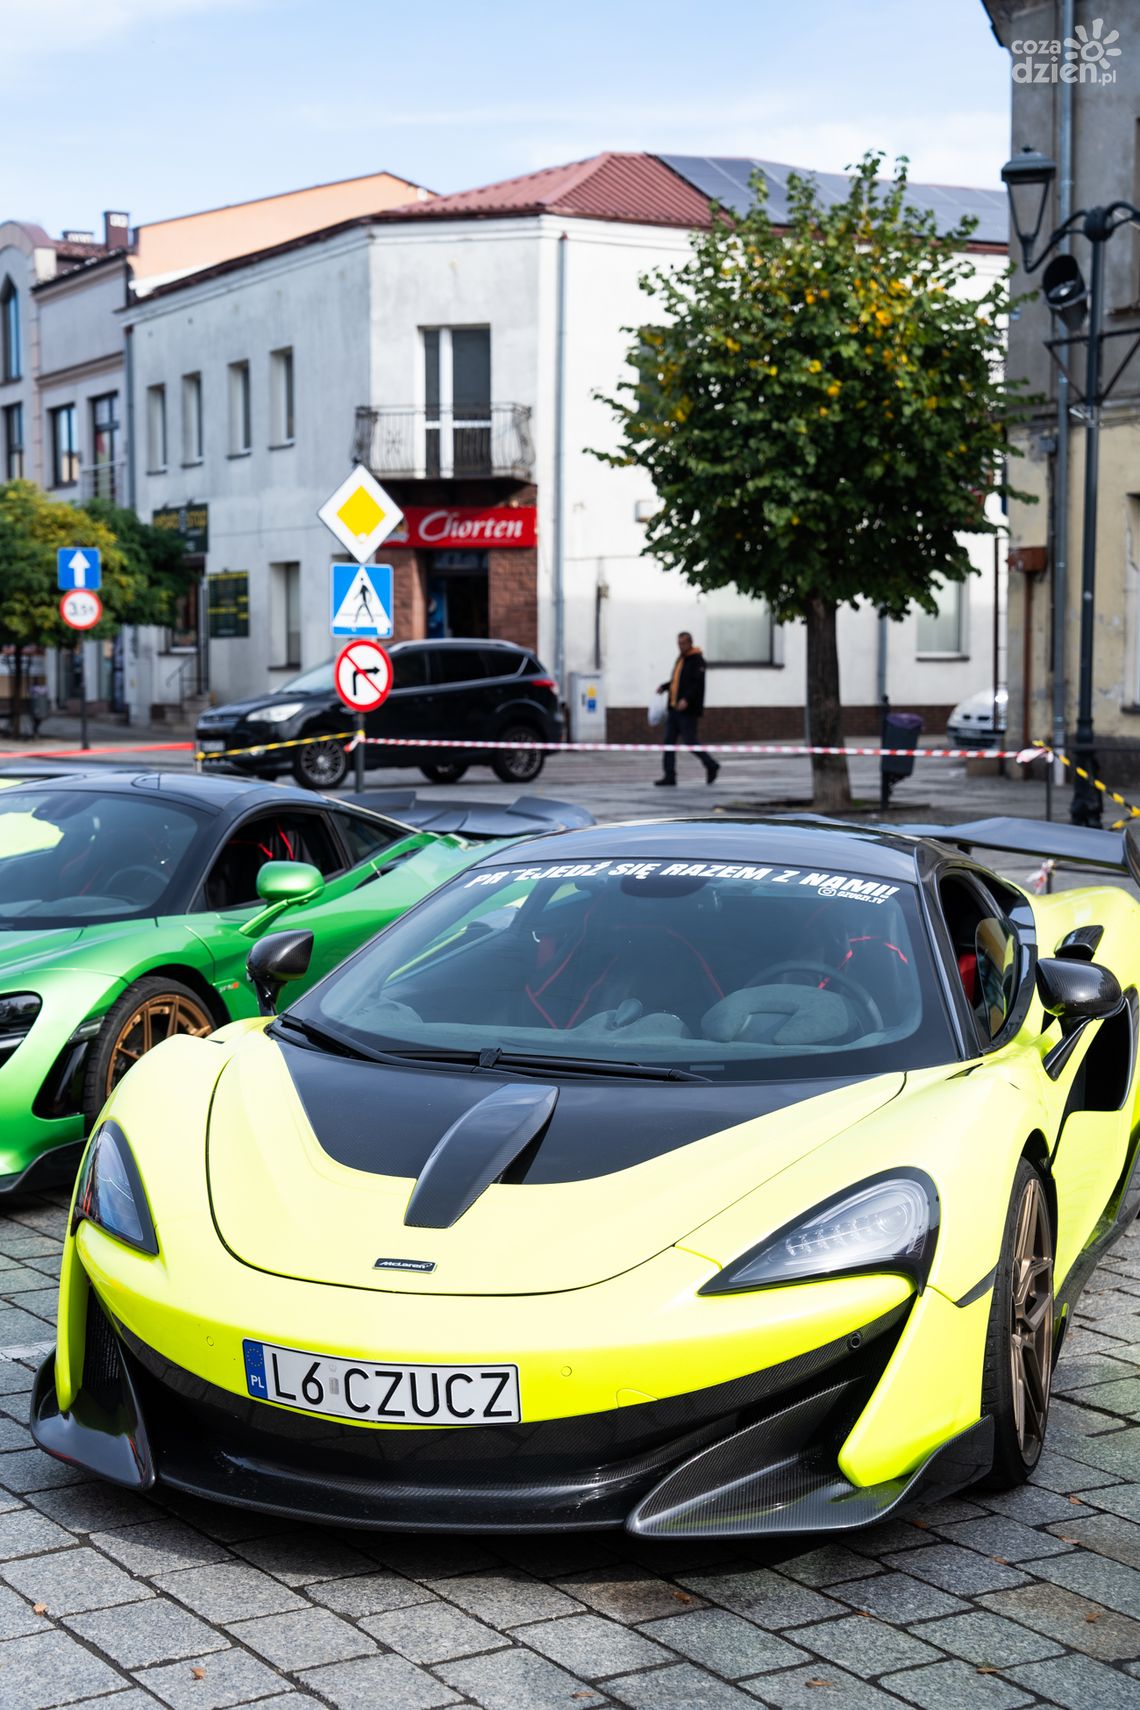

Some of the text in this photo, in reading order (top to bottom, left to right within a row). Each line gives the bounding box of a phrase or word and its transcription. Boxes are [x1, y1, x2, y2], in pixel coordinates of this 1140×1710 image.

[418, 510, 524, 542] Chorten
[463, 860, 900, 899] PRZEJEDŹ SIĘ RAZEM Z NAMI!!
[250, 1374, 265, 1389] PL
[271, 1353, 513, 1418] L6 CZUCZ
